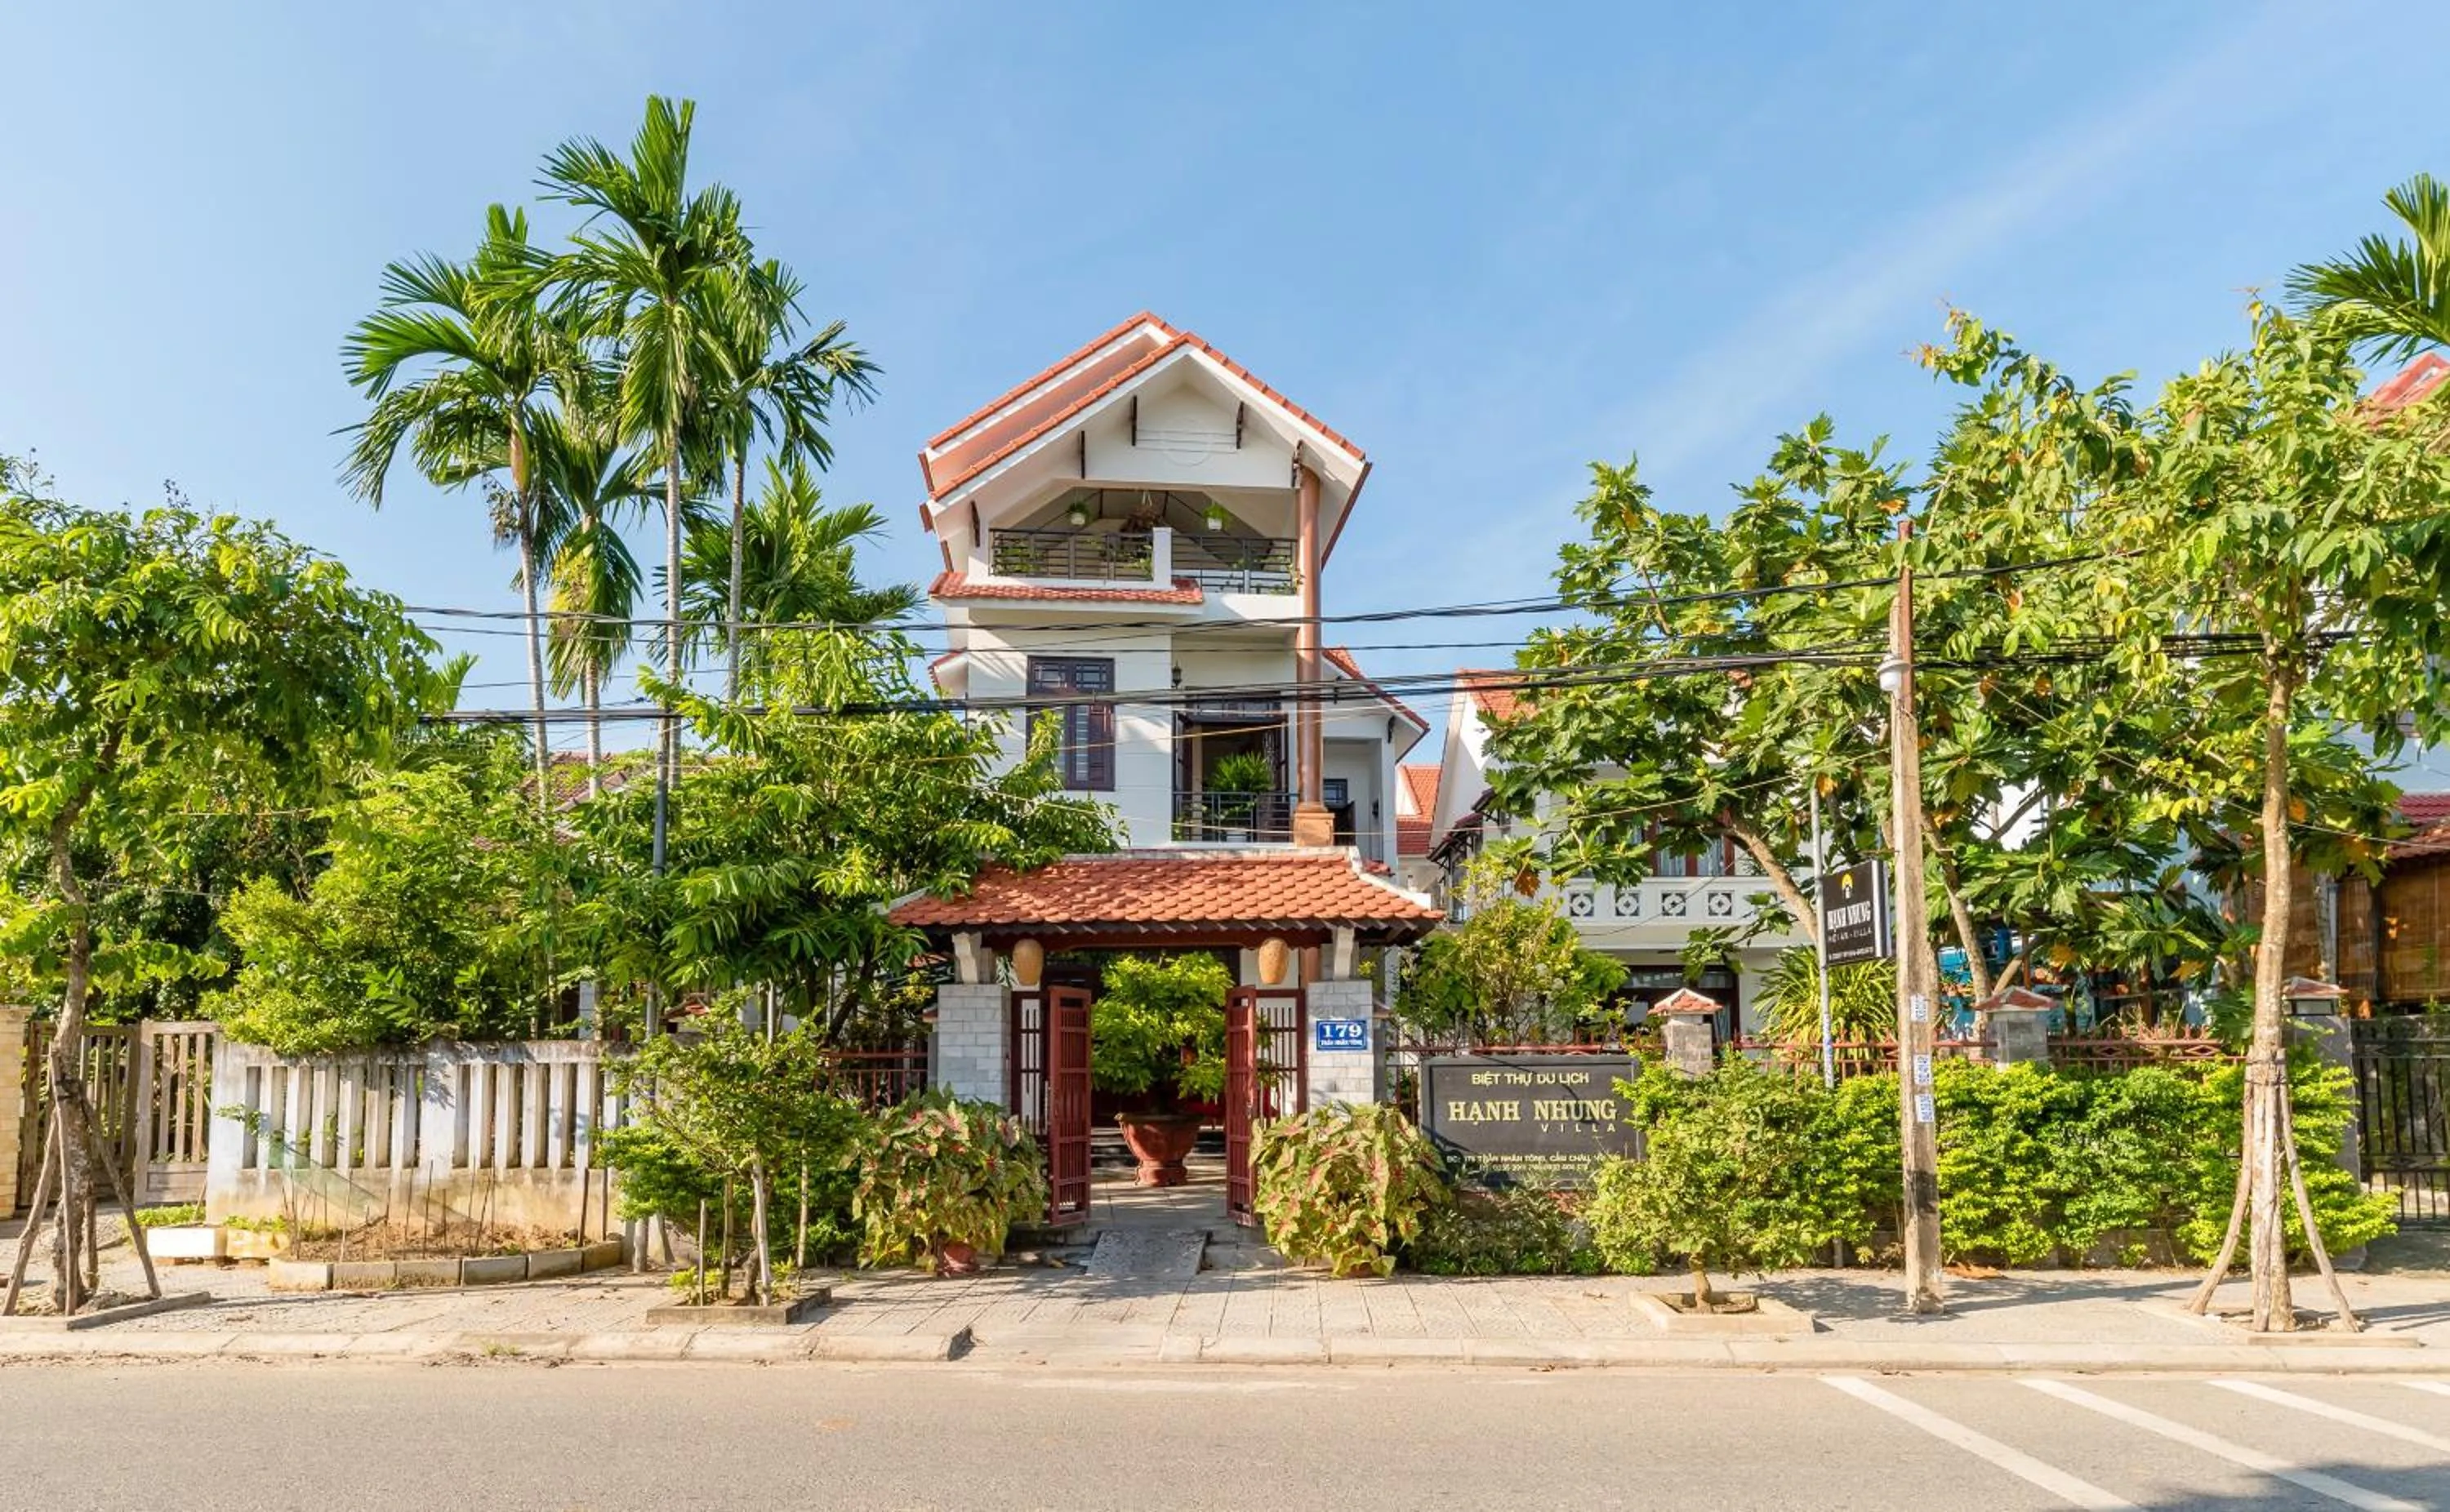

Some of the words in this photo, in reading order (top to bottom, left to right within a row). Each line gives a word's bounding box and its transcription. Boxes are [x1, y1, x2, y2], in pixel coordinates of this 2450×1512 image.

[1322, 1023, 1363, 1038] 179
[1472, 1070, 1501, 1087] BIỆT
[1504, 1072, 1532, 1087] THỰ
[1536, 1073, 1556, 1084] DU
[1558, 1072, 1589, 1085] LỊCH
[1448, 1101, 1521, 1126] HẠNH
[1533, 1099, 1617, 1121] NHUNG
[1541, 1123, 1615, 1132] VILLA
